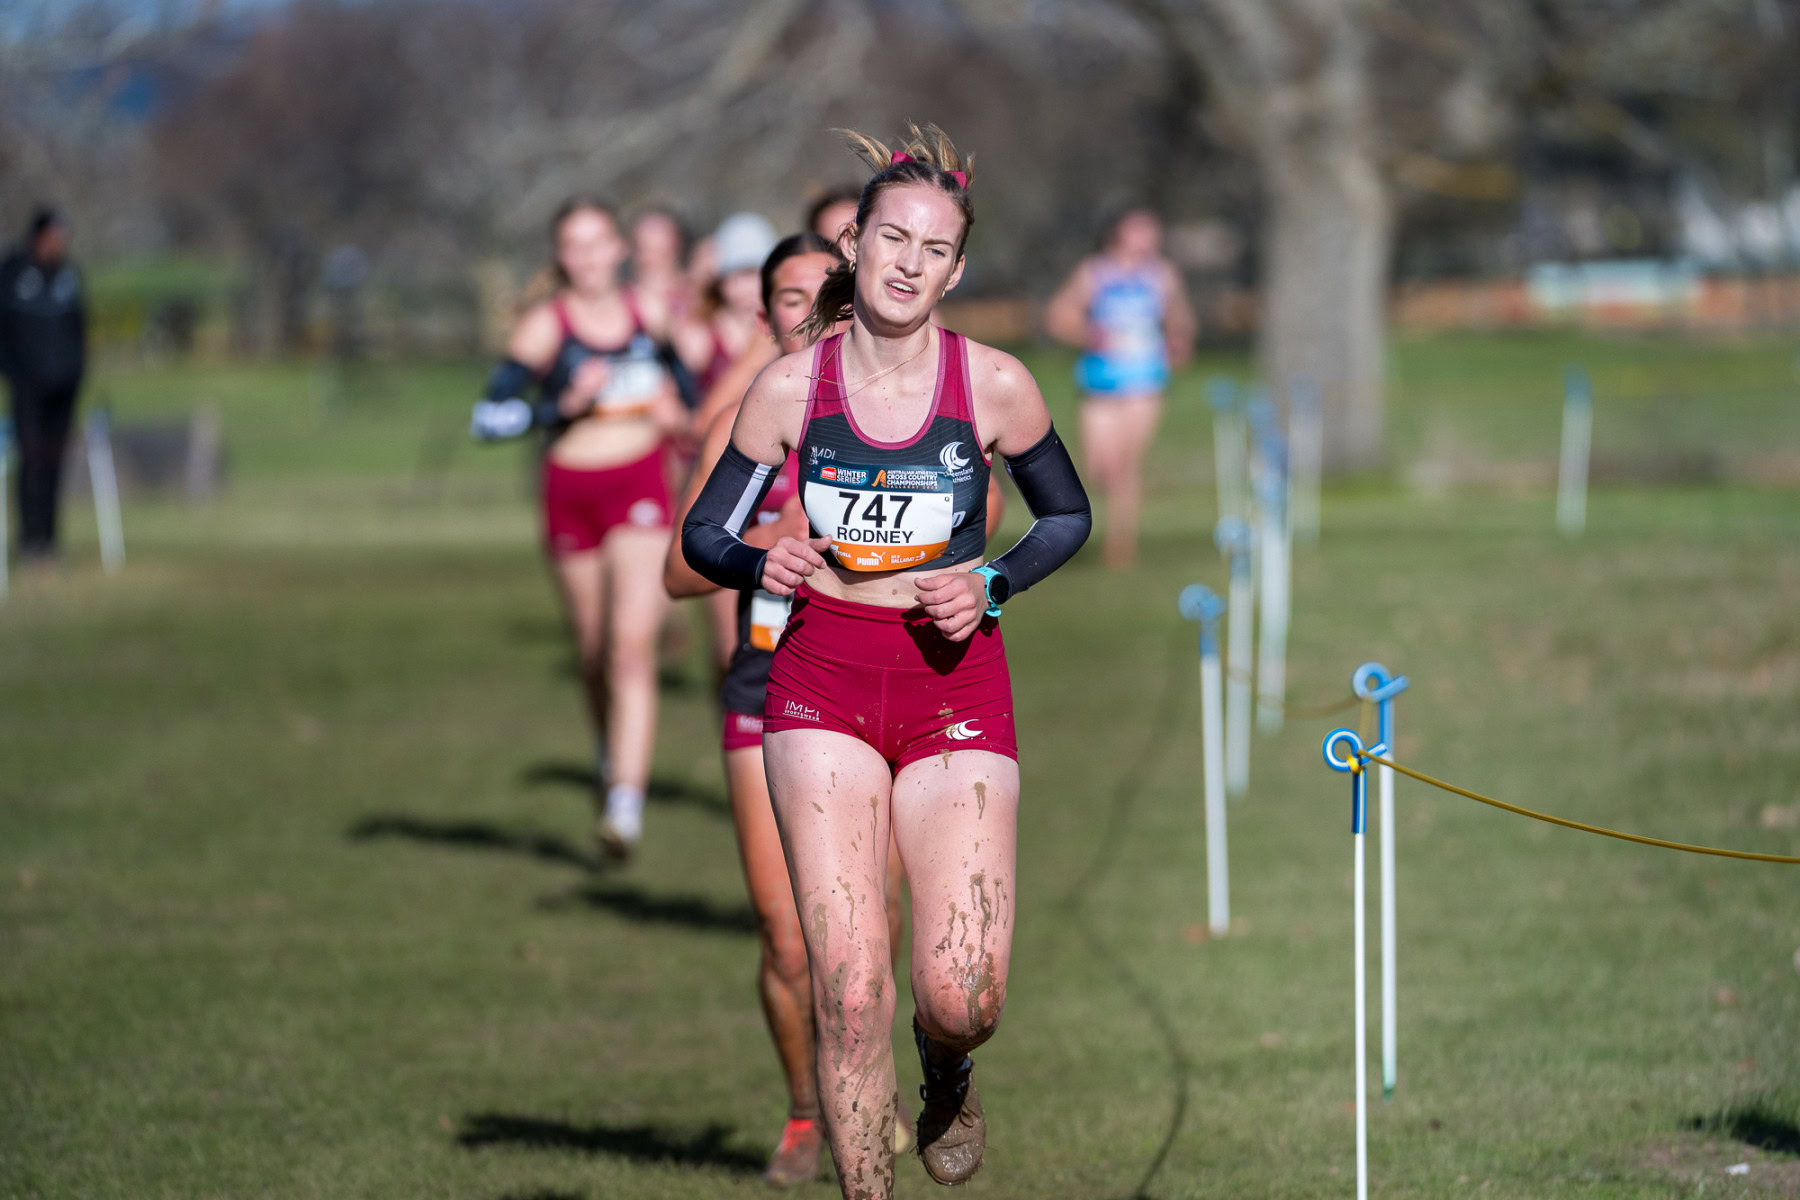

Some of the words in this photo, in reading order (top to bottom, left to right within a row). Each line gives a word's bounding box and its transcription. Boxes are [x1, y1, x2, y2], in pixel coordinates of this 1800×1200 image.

[837, 468, 867, 479] WINTER
[836, 475, 861, 484] SERIES
[887, 479, 938, 487] CHAMPIONSHIPS
[839, 491, 913, 529] 747
[837, 526, 914, 544] RODNEY
[857, 557, 880, 566] PUMA
